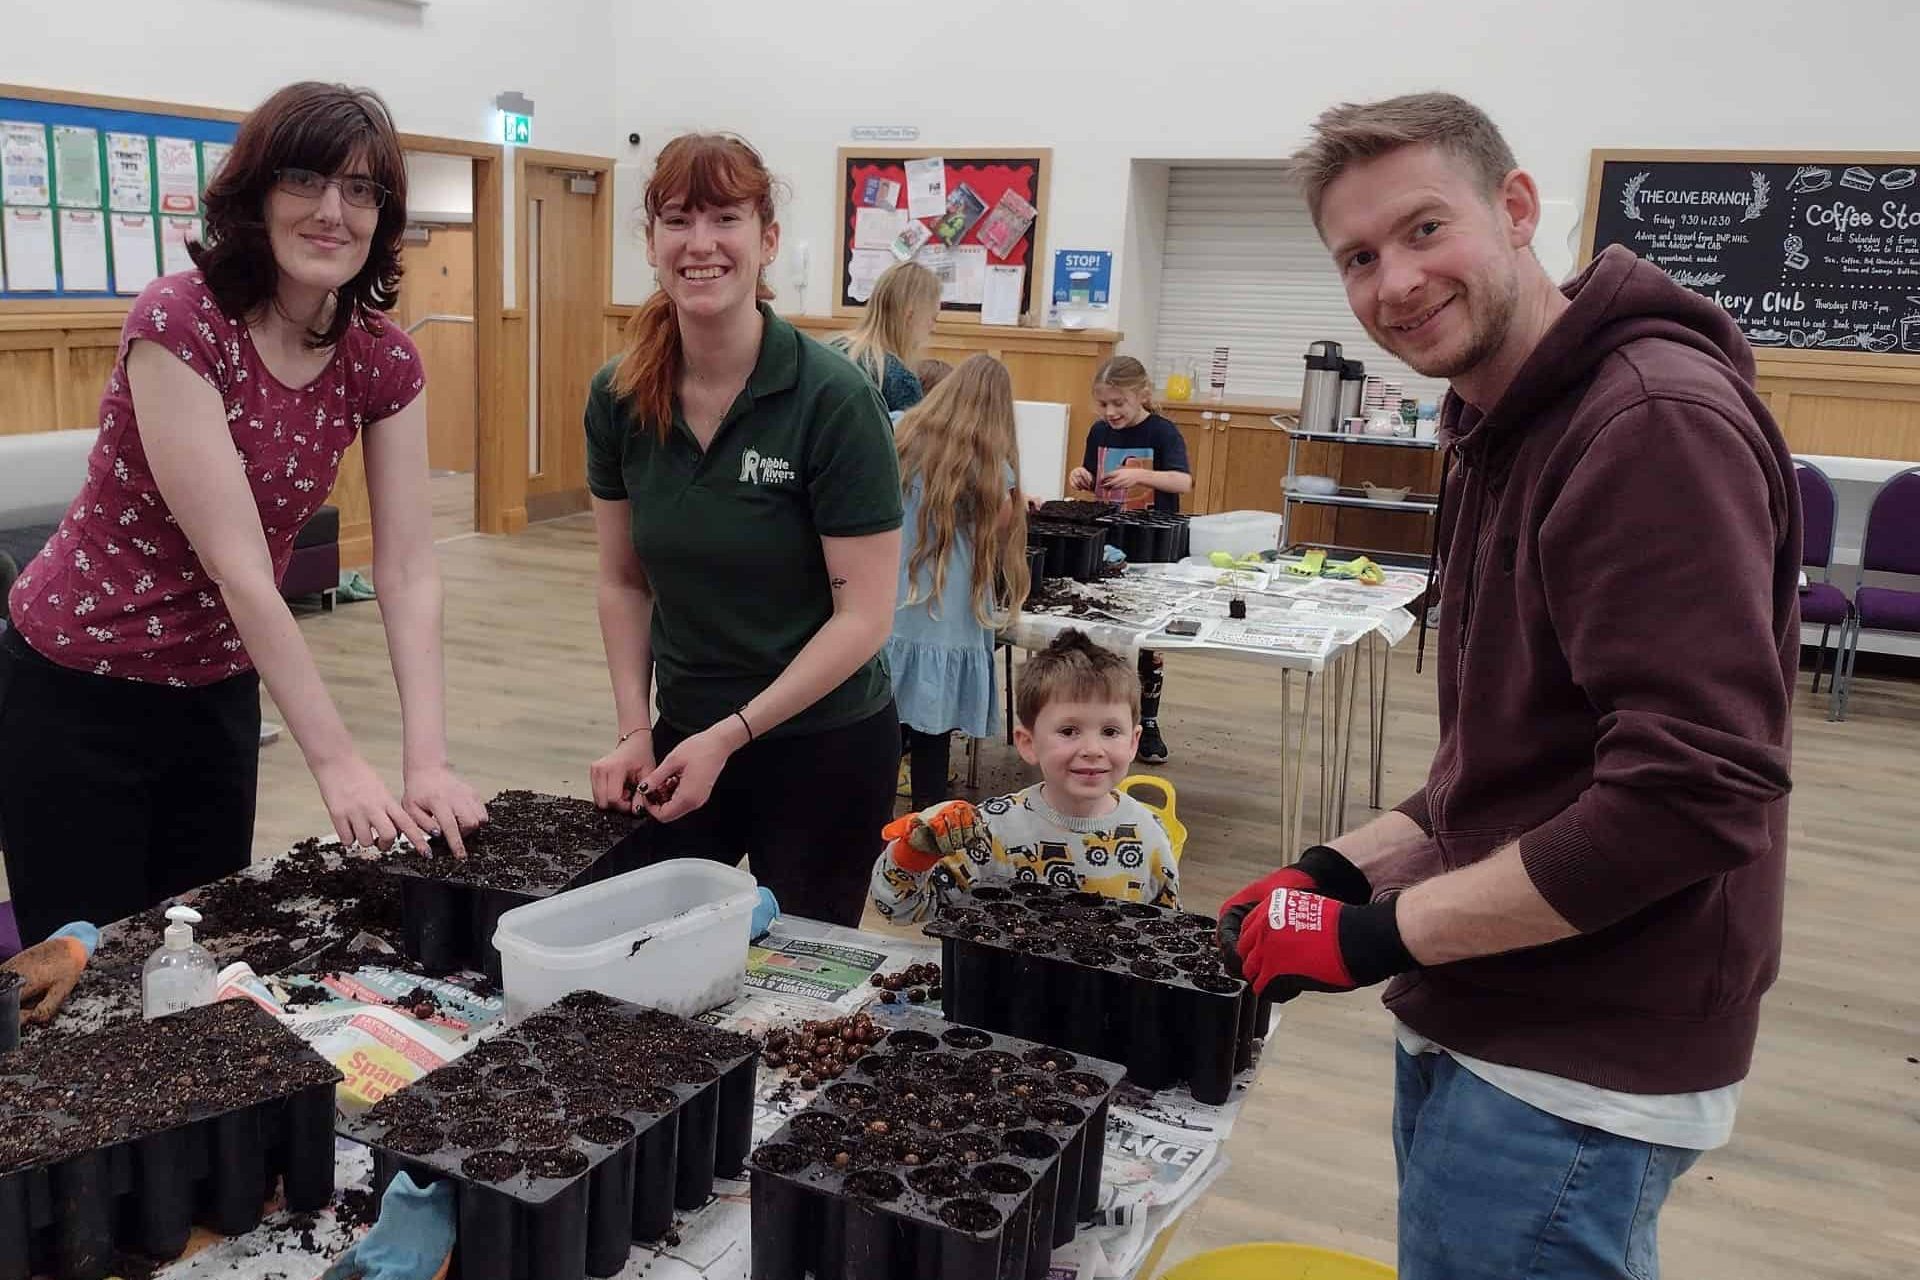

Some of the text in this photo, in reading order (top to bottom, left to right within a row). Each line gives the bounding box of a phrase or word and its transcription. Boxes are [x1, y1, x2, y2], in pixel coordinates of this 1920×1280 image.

[1640, 190, 1750, 206] THE OLIVE BRANCH
[1653, 214, 1675, 230] Friday
[1806, 201, 1920, 232] Coffee Sto
[1659, 231, 1670, 241] and
[1826, 232, 1844, 243] Last
[1848, 233, 1881, 247] Saturday
[1886, 235, 1894, 246] of
[1065, 254, 1101, 267] STOP!
[1711, 290, 1753, 314] kery
[1762, 291, 1806, 313] Club
[1751, 316, 1767, 328] want
[760, 457, 790, 470] Ribble
[762, 468, 795, 482] Rivers
[776, 983, 831, 999] DRIVEWAY
[360, 1079, 385, 1101] lo
